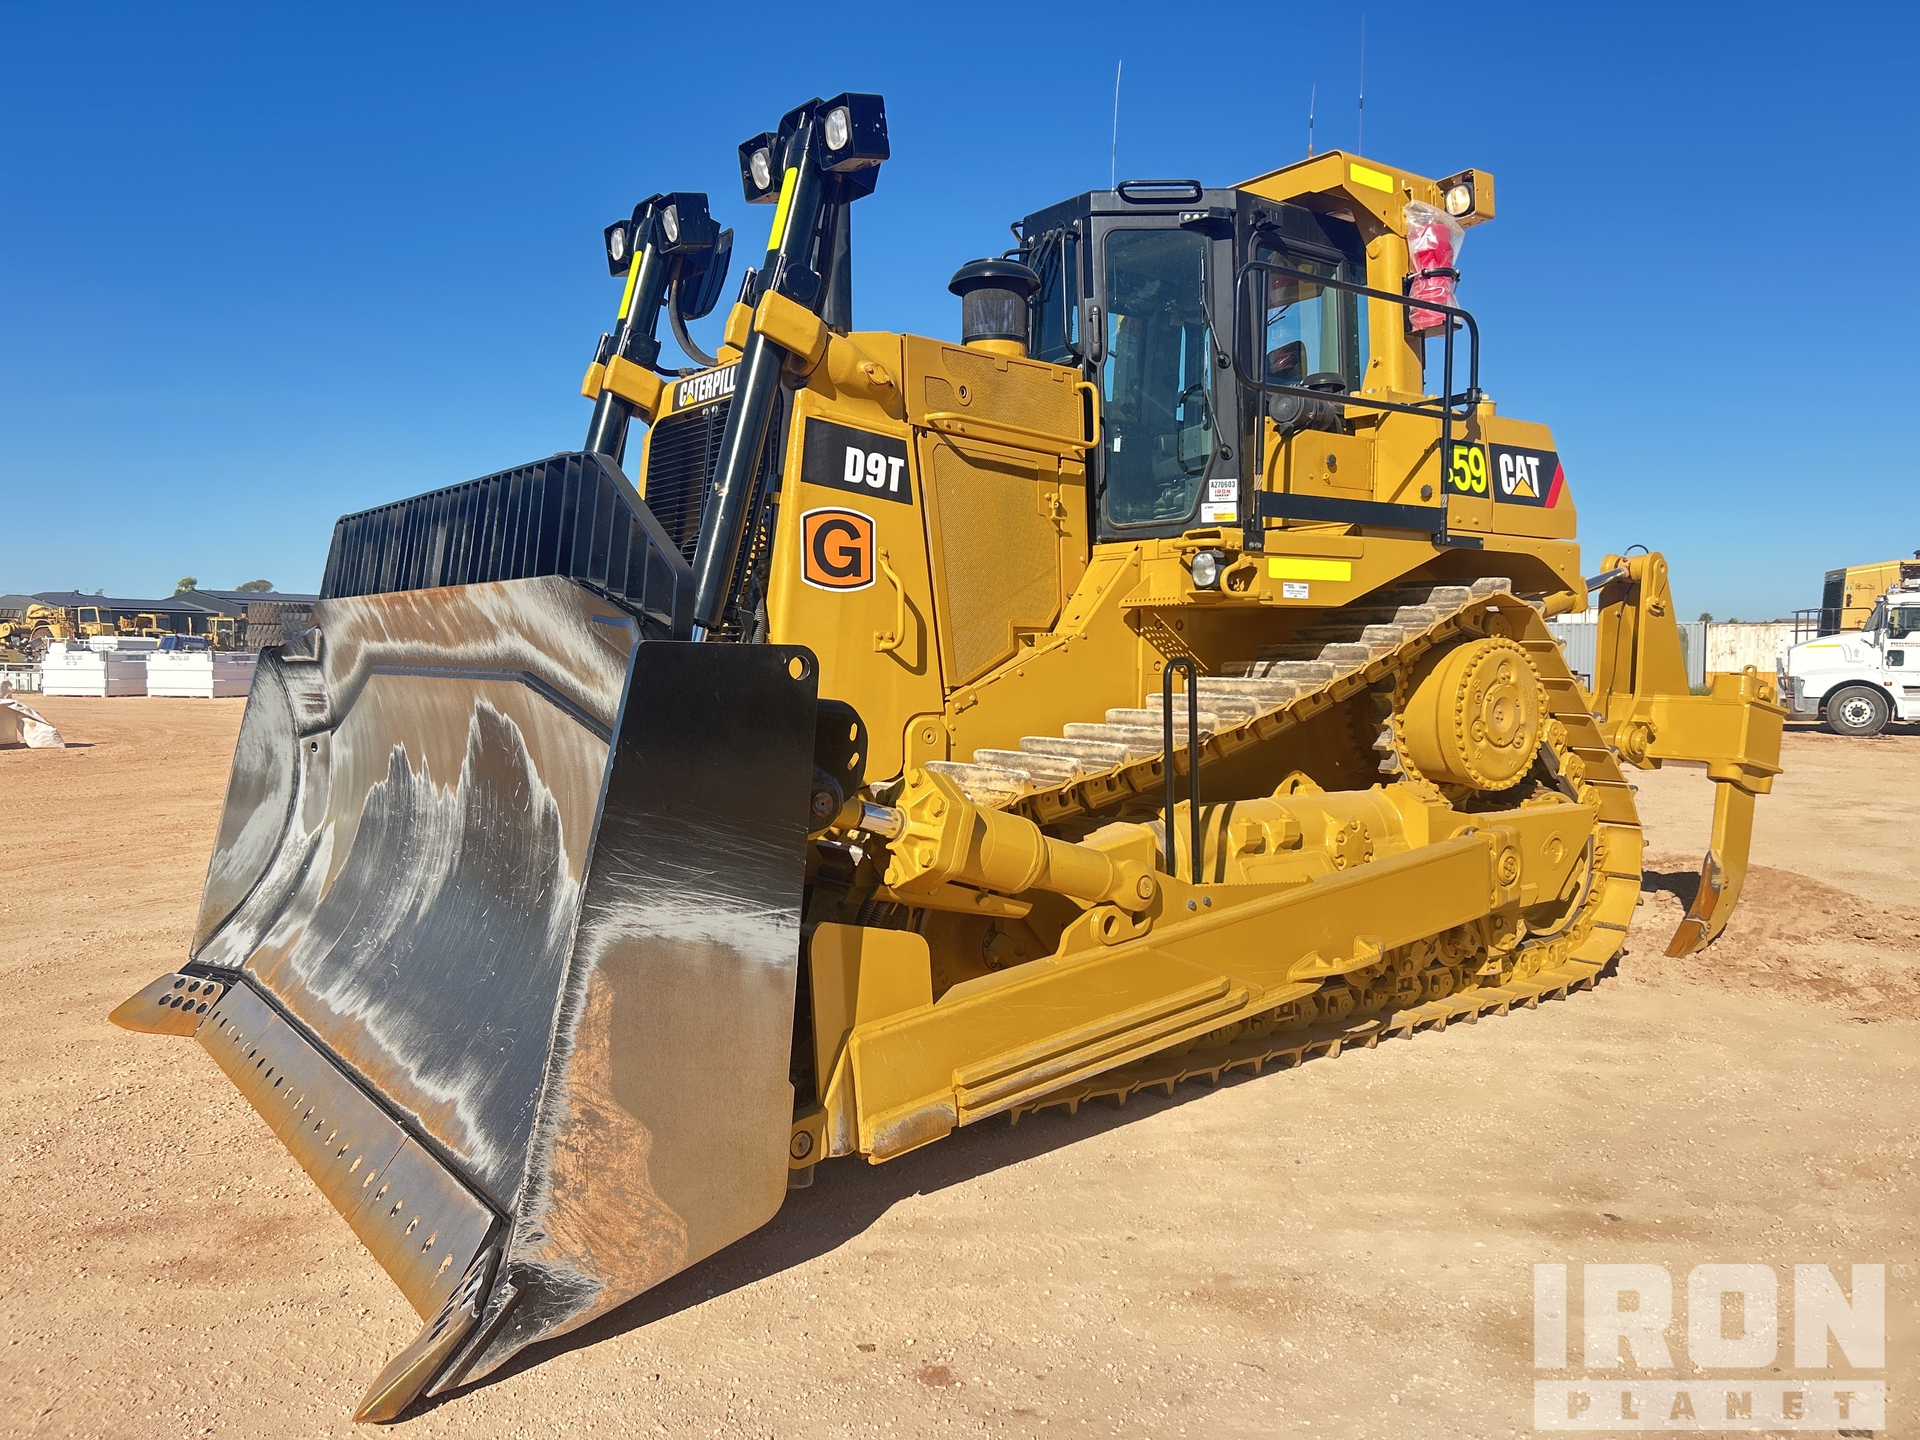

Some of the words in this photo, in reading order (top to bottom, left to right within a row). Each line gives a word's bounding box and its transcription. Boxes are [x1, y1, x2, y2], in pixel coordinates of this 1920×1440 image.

[843, 446, 905, 493] D9T
[1447, 444, 1487, 494] 59
[1498, 453, 1540, 498] CAT
[812, 518, 862, 578] G
